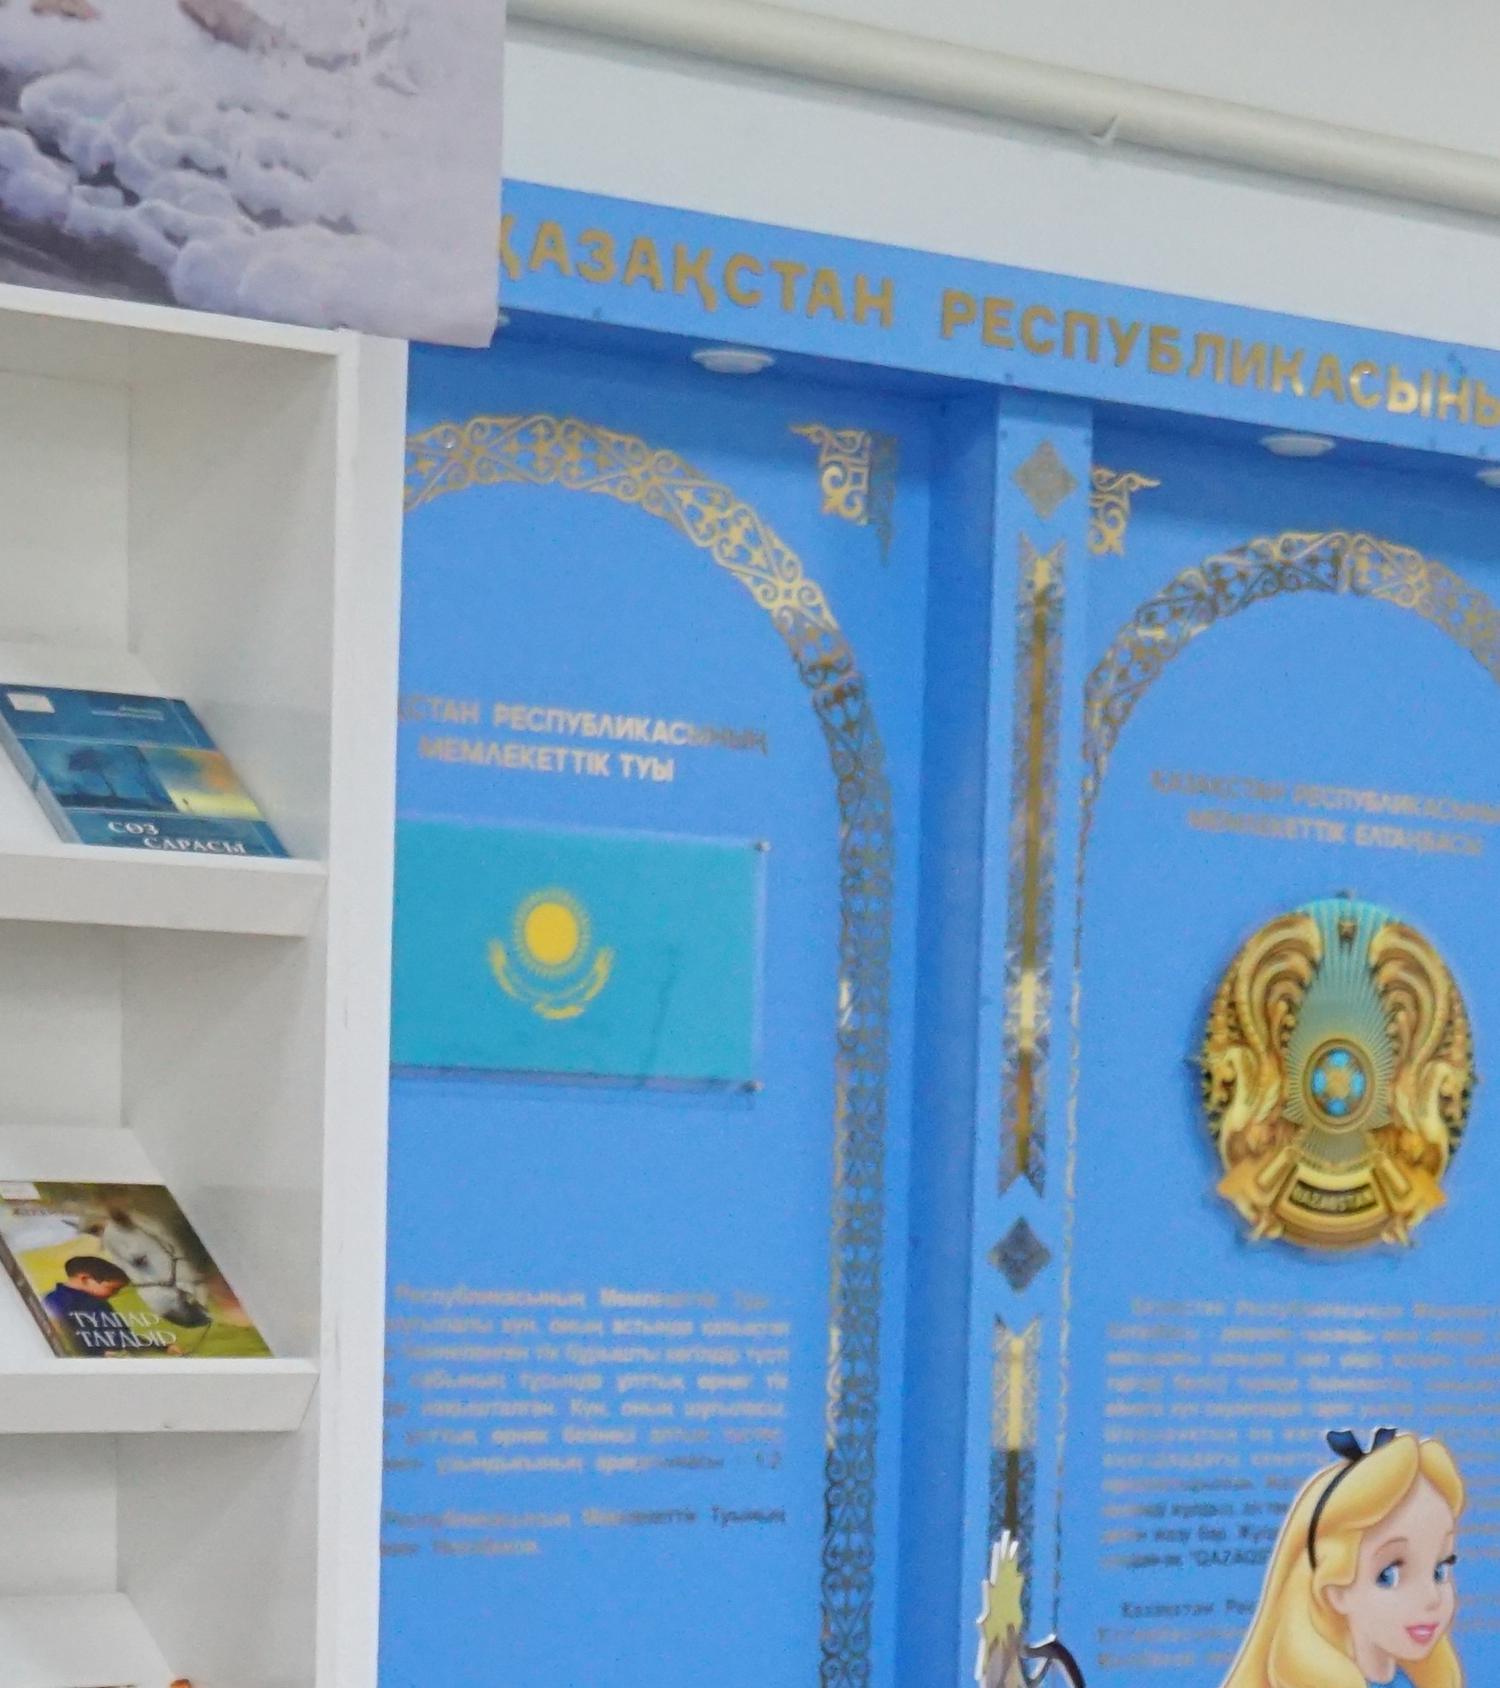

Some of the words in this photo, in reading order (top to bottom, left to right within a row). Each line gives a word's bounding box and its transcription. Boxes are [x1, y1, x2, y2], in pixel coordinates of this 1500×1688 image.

[492, 702, 768, 755] РЕСПУБЛИКАСЫНЫҢ
[419, 735, 610, 777] МЕМЛЕКЕТТІК
[620, 753, 675, 782] ТУЫ
